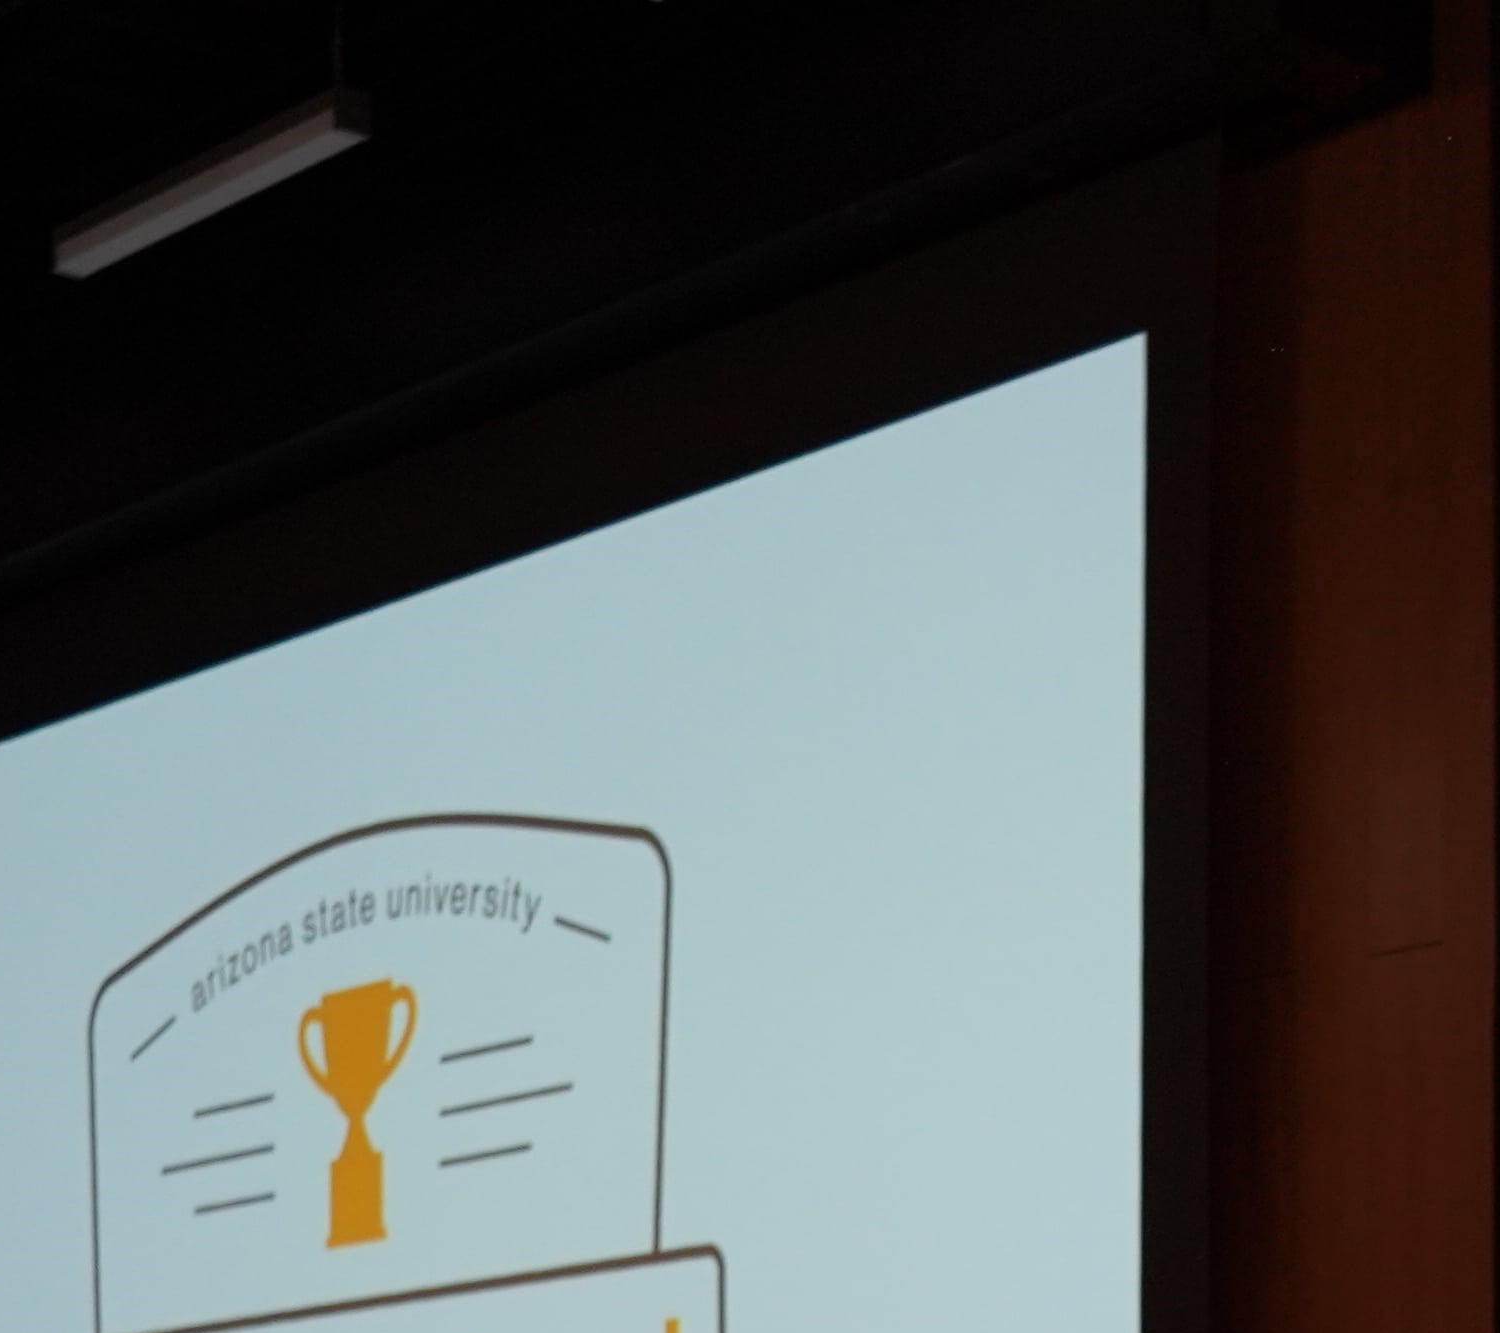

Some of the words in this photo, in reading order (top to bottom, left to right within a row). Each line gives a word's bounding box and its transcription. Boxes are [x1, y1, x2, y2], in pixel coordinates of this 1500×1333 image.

[190, 926, 293, 1012] arizona
[301, 893, 376, 947] state
[386, 874, 542, 934] university
